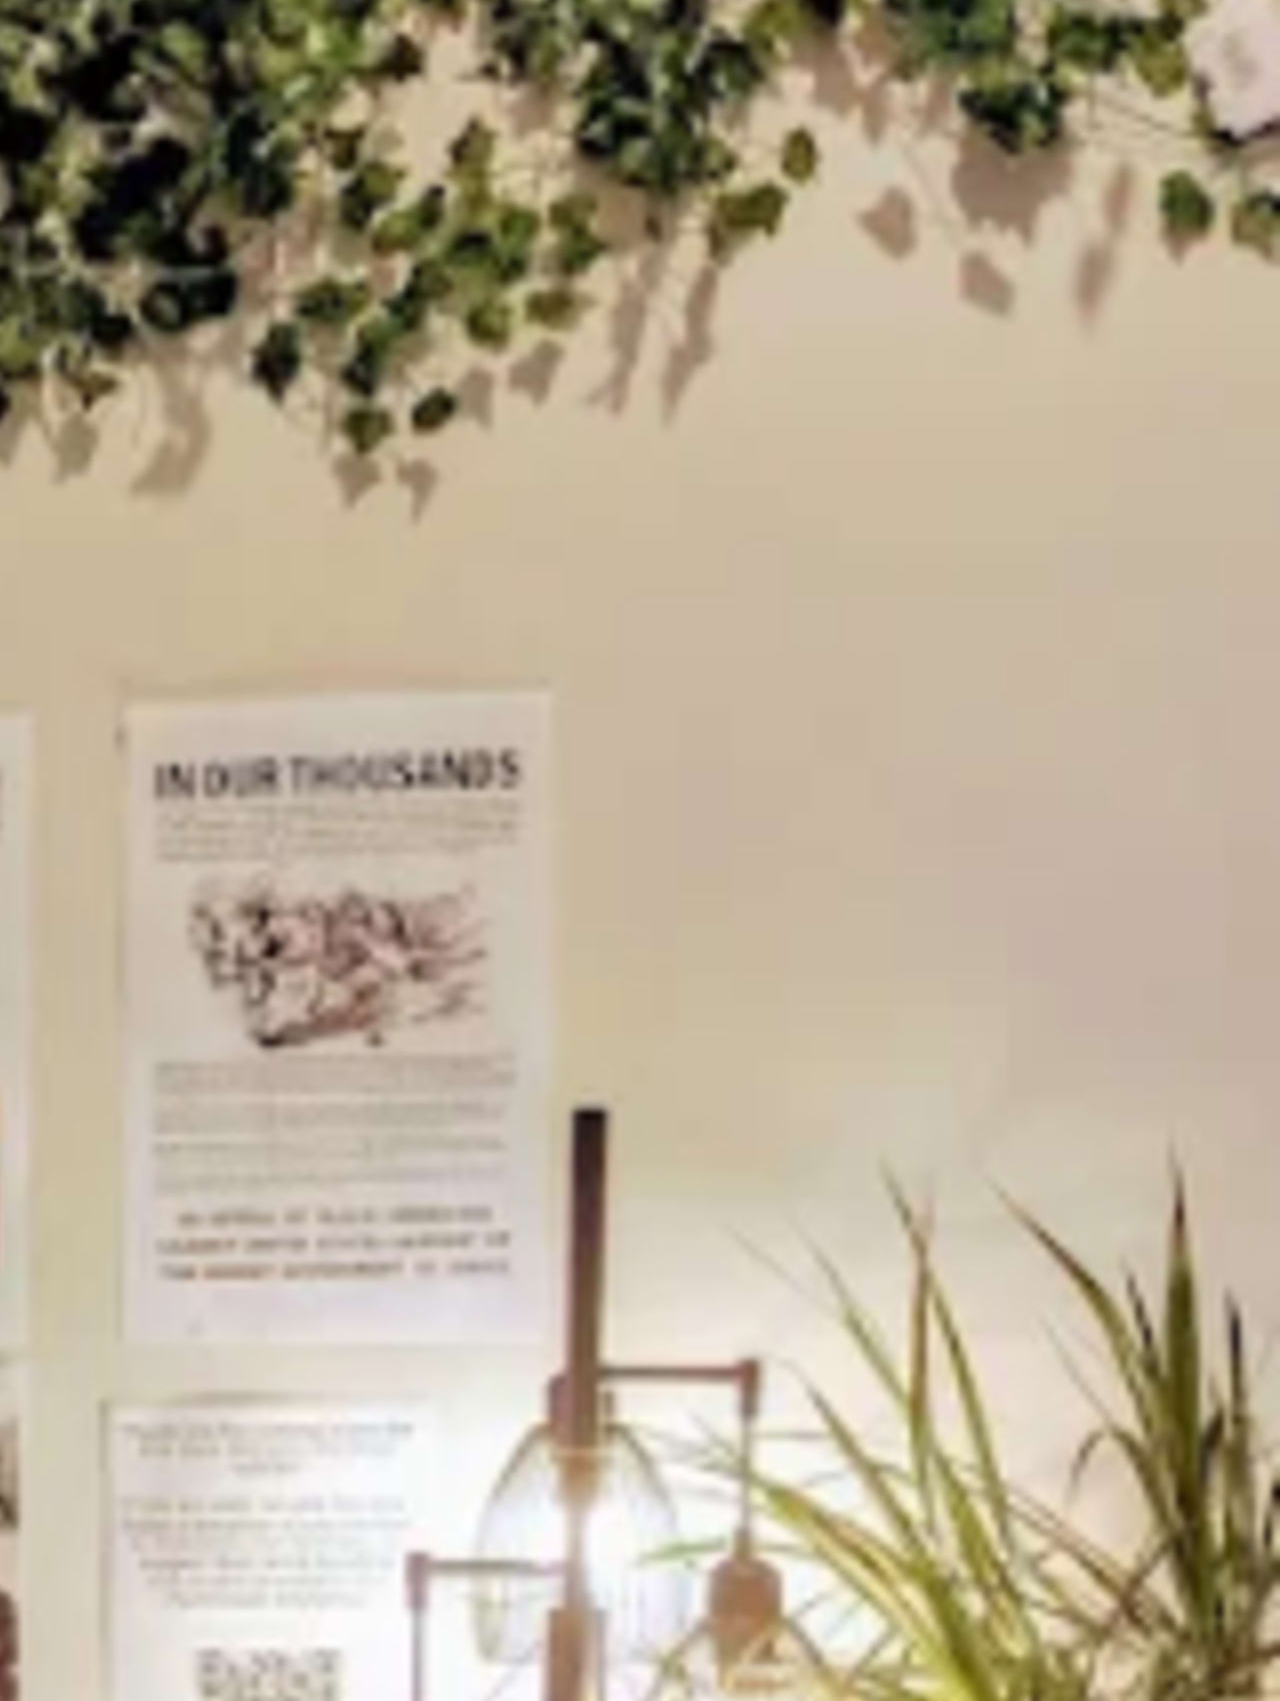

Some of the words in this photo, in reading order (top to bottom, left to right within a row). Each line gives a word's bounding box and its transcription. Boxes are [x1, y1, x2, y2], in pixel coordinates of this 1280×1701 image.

[153, 762, 196, 800] IN
[202, 756, 278, 800] OUR
[290, 745, 520, 793] THOUSANDS
